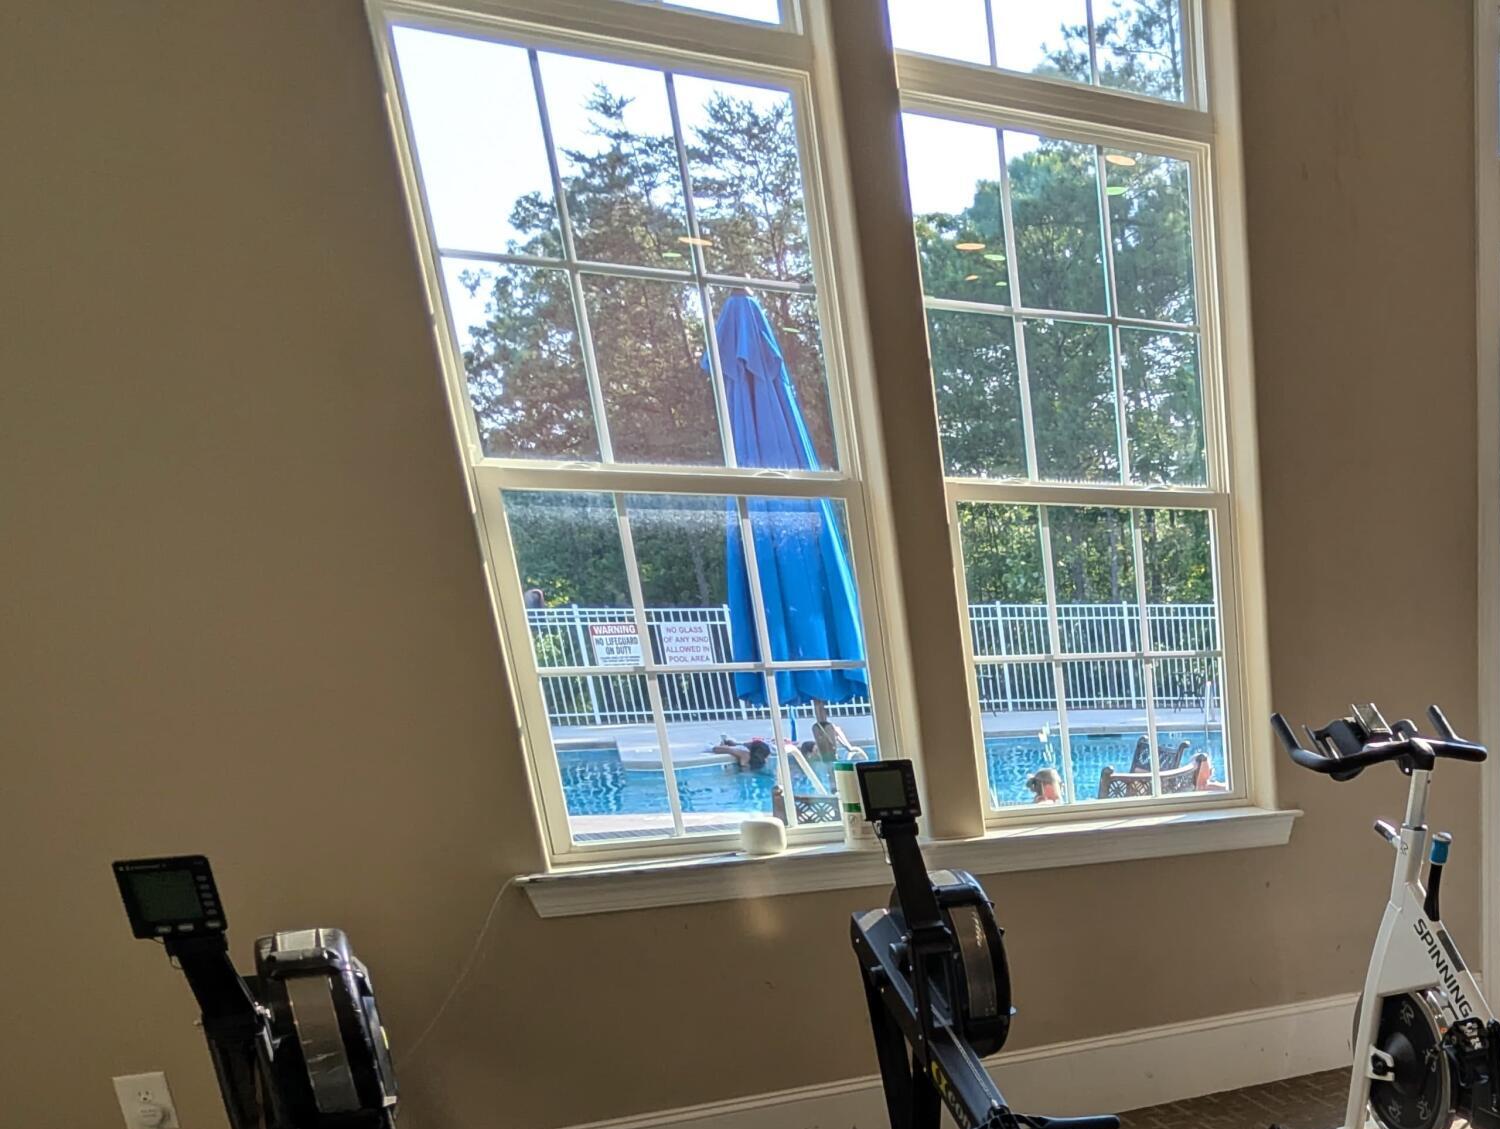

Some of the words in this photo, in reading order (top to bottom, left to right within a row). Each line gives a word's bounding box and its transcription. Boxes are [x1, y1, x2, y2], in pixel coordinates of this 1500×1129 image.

[593, 625, 637, 635] WARNING
[666, 626, 677, 634] NO
[679, 626, 703, 634] GLASS
[595, 637, 605, 646] NO
[605, 636, 639, 646] LIFEGUARD
[606, 646, 615, 655] ON
[616, 646, 632, 655] DUTY
[666, 645, 701, 653] ALLOWED
[1413, 918, 1473, 1018] SPINNING
